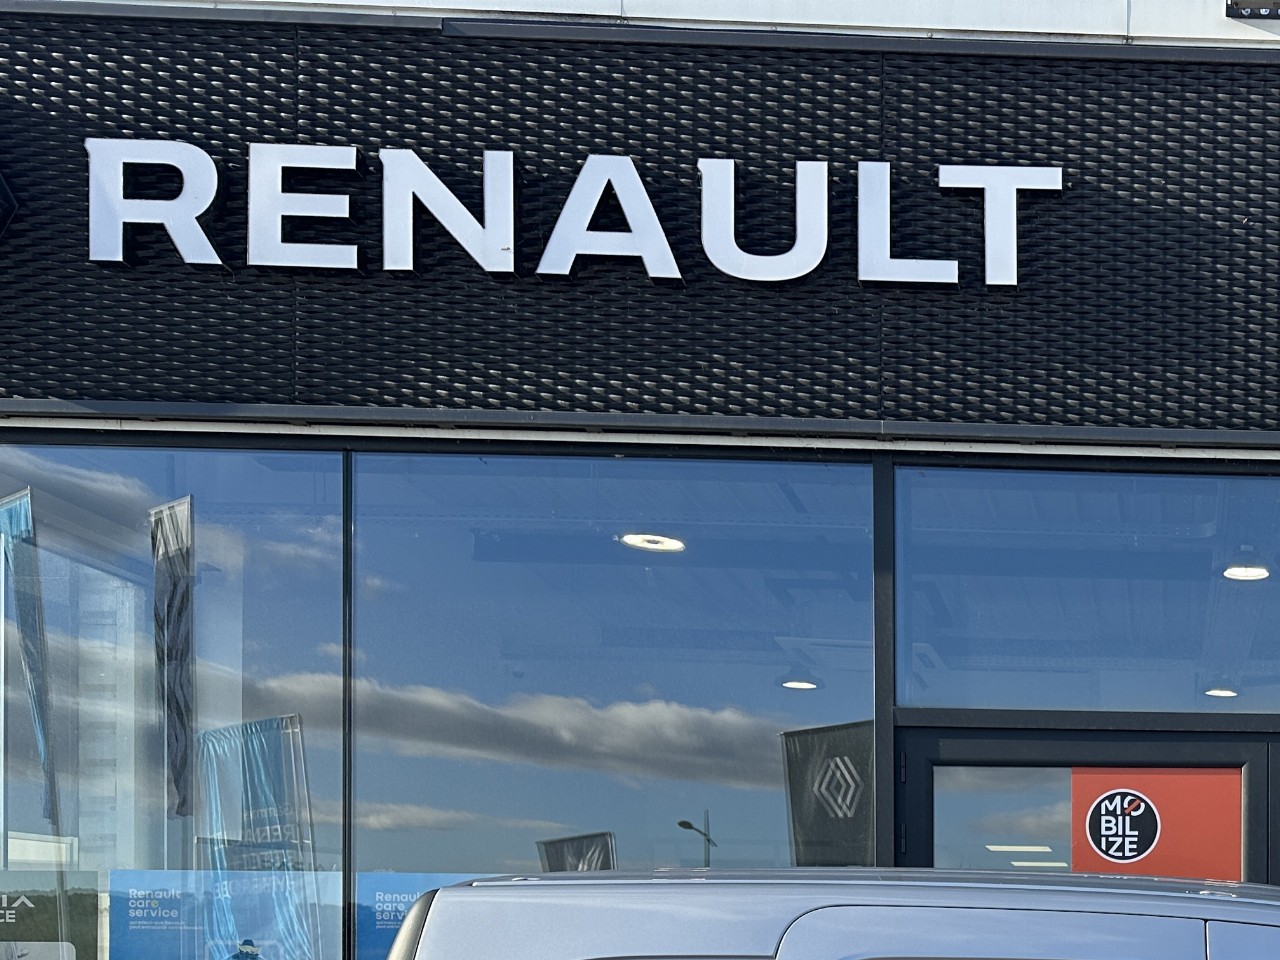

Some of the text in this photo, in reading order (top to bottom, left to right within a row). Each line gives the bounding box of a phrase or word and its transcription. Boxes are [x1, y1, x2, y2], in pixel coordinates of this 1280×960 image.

[84, 137, 1064, 287] RENAULT
[129, 888, 182, 899] Renault
[129, 900, 159, 908] care
[376, 902, 406, 911] care
[129, 907, 179, 918] service
